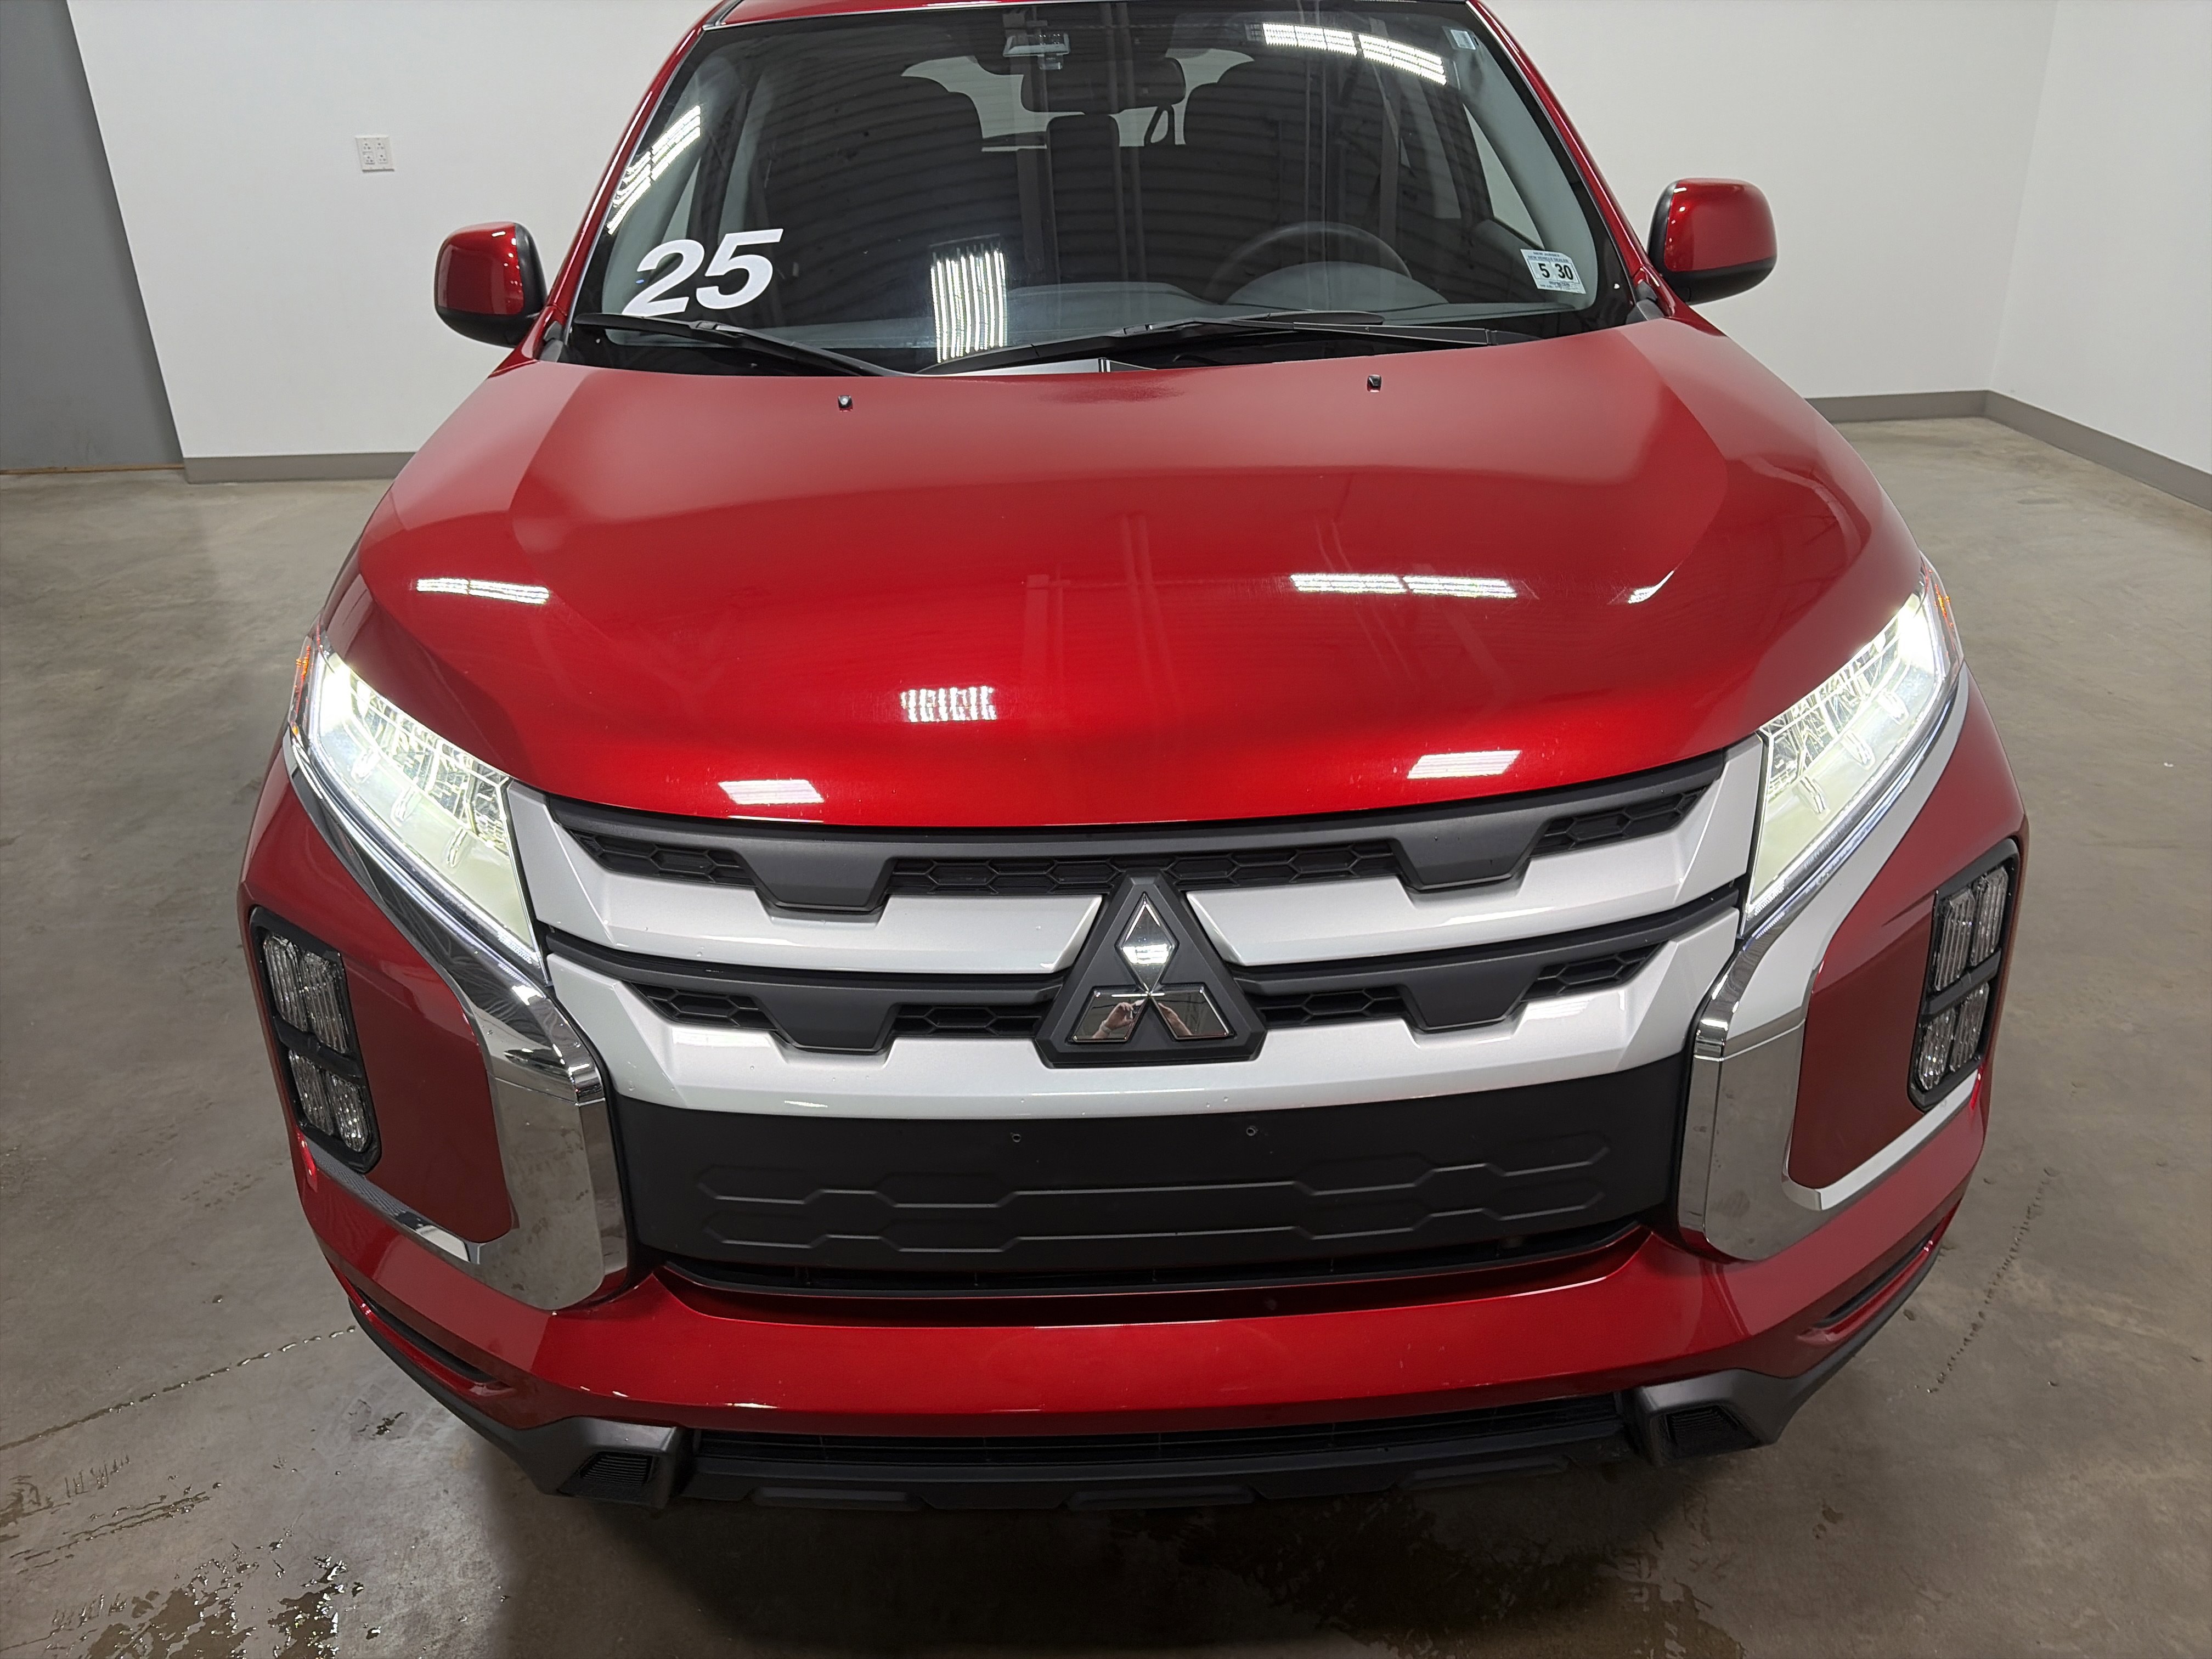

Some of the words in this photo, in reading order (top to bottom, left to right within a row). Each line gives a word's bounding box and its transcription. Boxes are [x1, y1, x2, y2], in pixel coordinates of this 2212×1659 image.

[622, 229, 783, 317] 25
[1538, 263, 1550, 278] 5
[1555, 263, 1573, 280] 30
